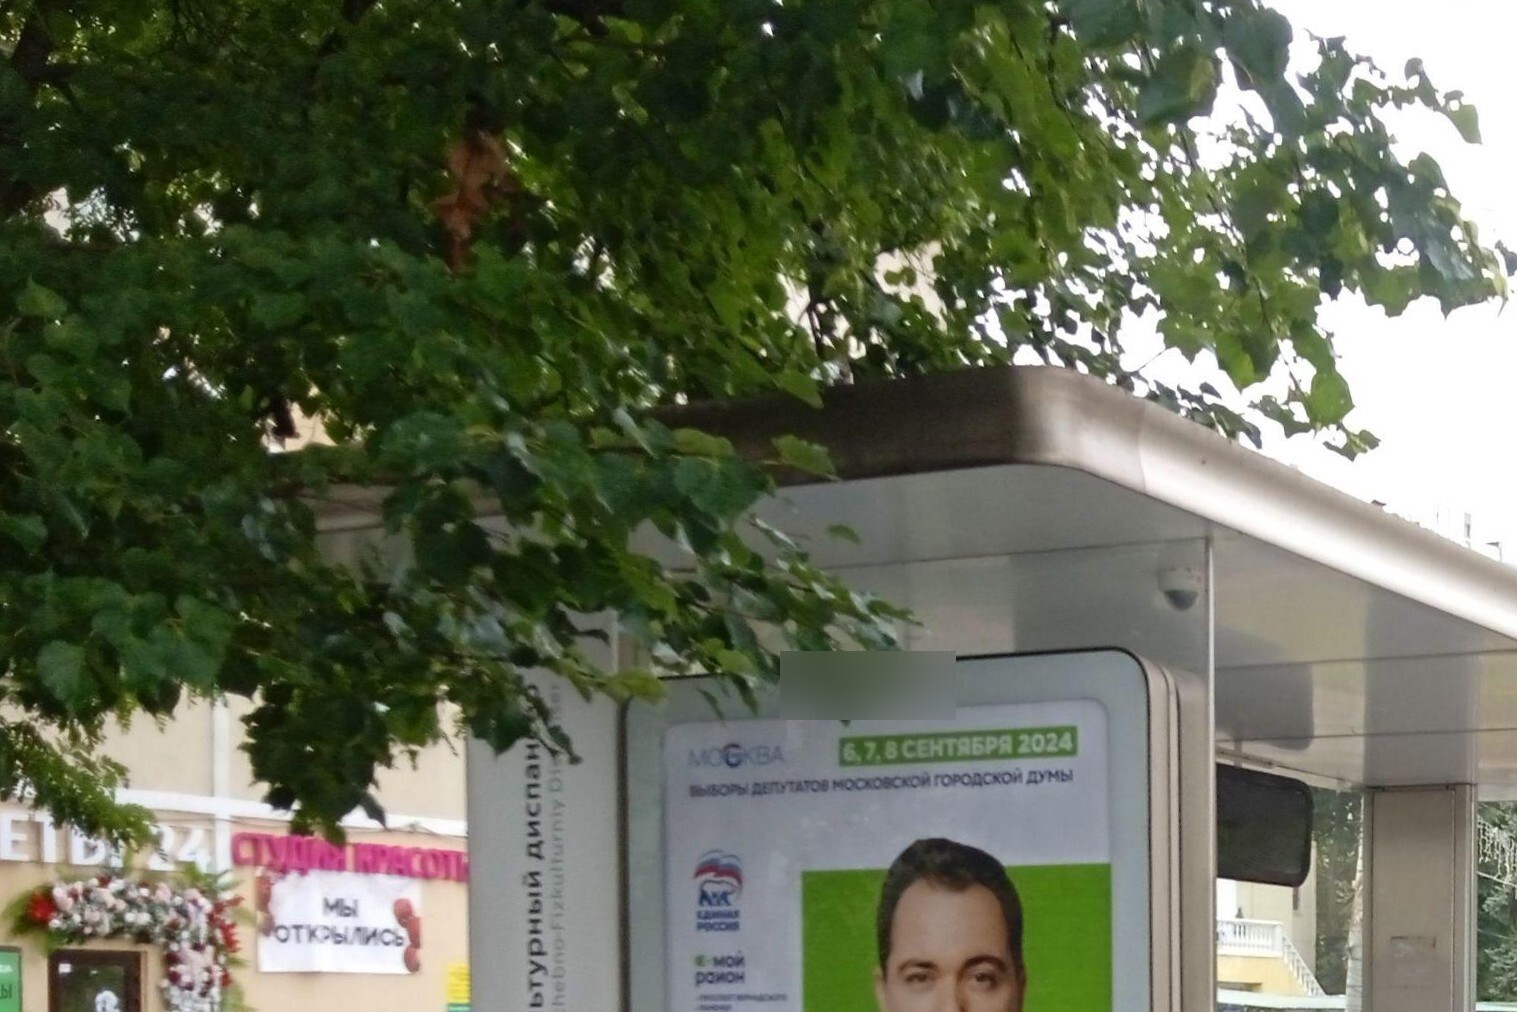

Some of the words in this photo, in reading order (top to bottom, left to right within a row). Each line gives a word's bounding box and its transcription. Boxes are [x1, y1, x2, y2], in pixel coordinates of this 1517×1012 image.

[843, 742, 861, 763] 6,
[865, 741, 881, 762] 7,
[885, 740, 898, 760] 8
[902, 734, 1013, 759] СЕНТЯБРЯ
[1018, 731, 1073, 754] 2024
[689, 782, 749, 798] ВЫБОРЫ
[752, 779, 830, 796] ДЕПУТАТОВ
[832, 771, 931, 791] МОСКОВСКОЙ
[935, 768, 1023, 787] ГОРОДСКОЙ
[1026, 769, 1074, 785] ДУМЫ
[0, 809, 124, 868] ЕТЫ
[323, 897, 359, 918] МЫ
[274, 924, 405, 947] ОТКРЫЛИСЬ
